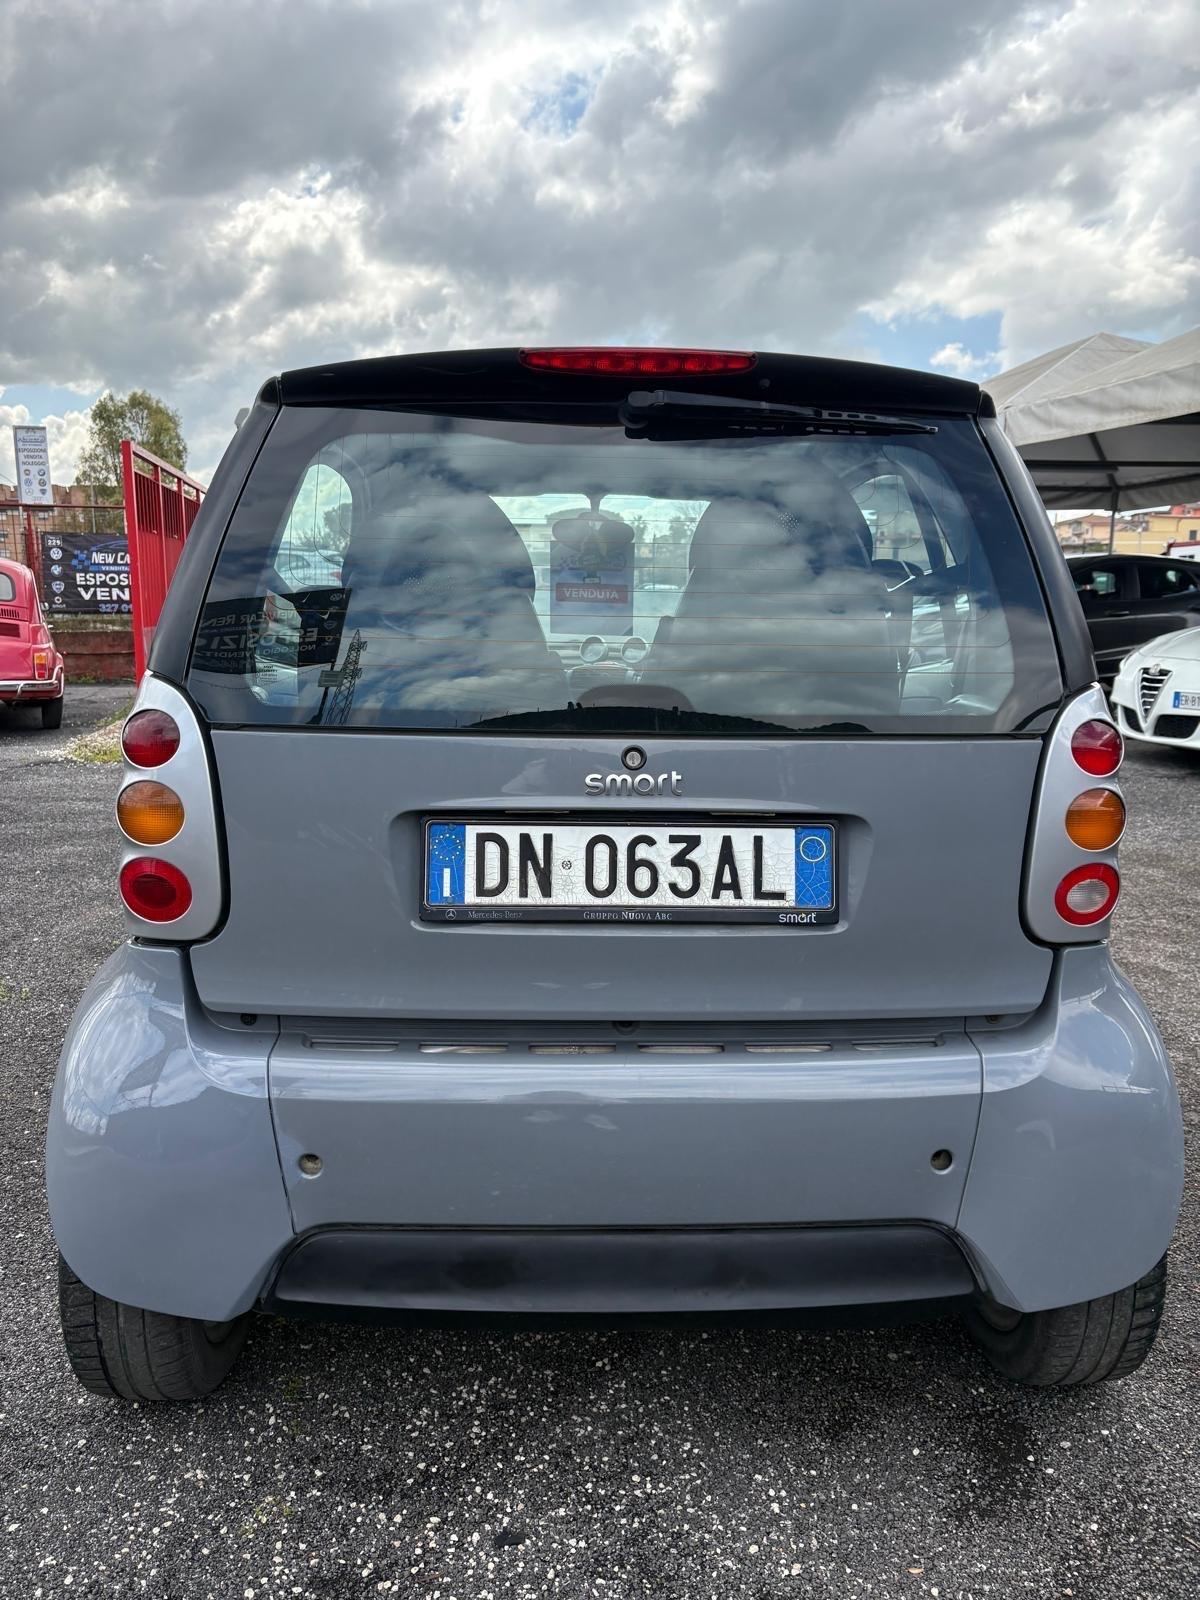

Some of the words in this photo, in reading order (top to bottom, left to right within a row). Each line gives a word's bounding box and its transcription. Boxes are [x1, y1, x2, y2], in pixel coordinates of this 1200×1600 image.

[91, 551, 115, 564] NEW
[117, 552, 131, 564] CA
[76, 573, 132, 586] ESPOSI
[77, 587, 130, 600] VEN
[562, 587, 619, 599] VENDUTA
[584, 771, 682, 797] smart
[475, 832, 553, 898] DN
[584, 833, 786, 901] 063AL
[467, 911, 523, 919] Mercedes-Benz
[778, 911, 817, 924] smart
